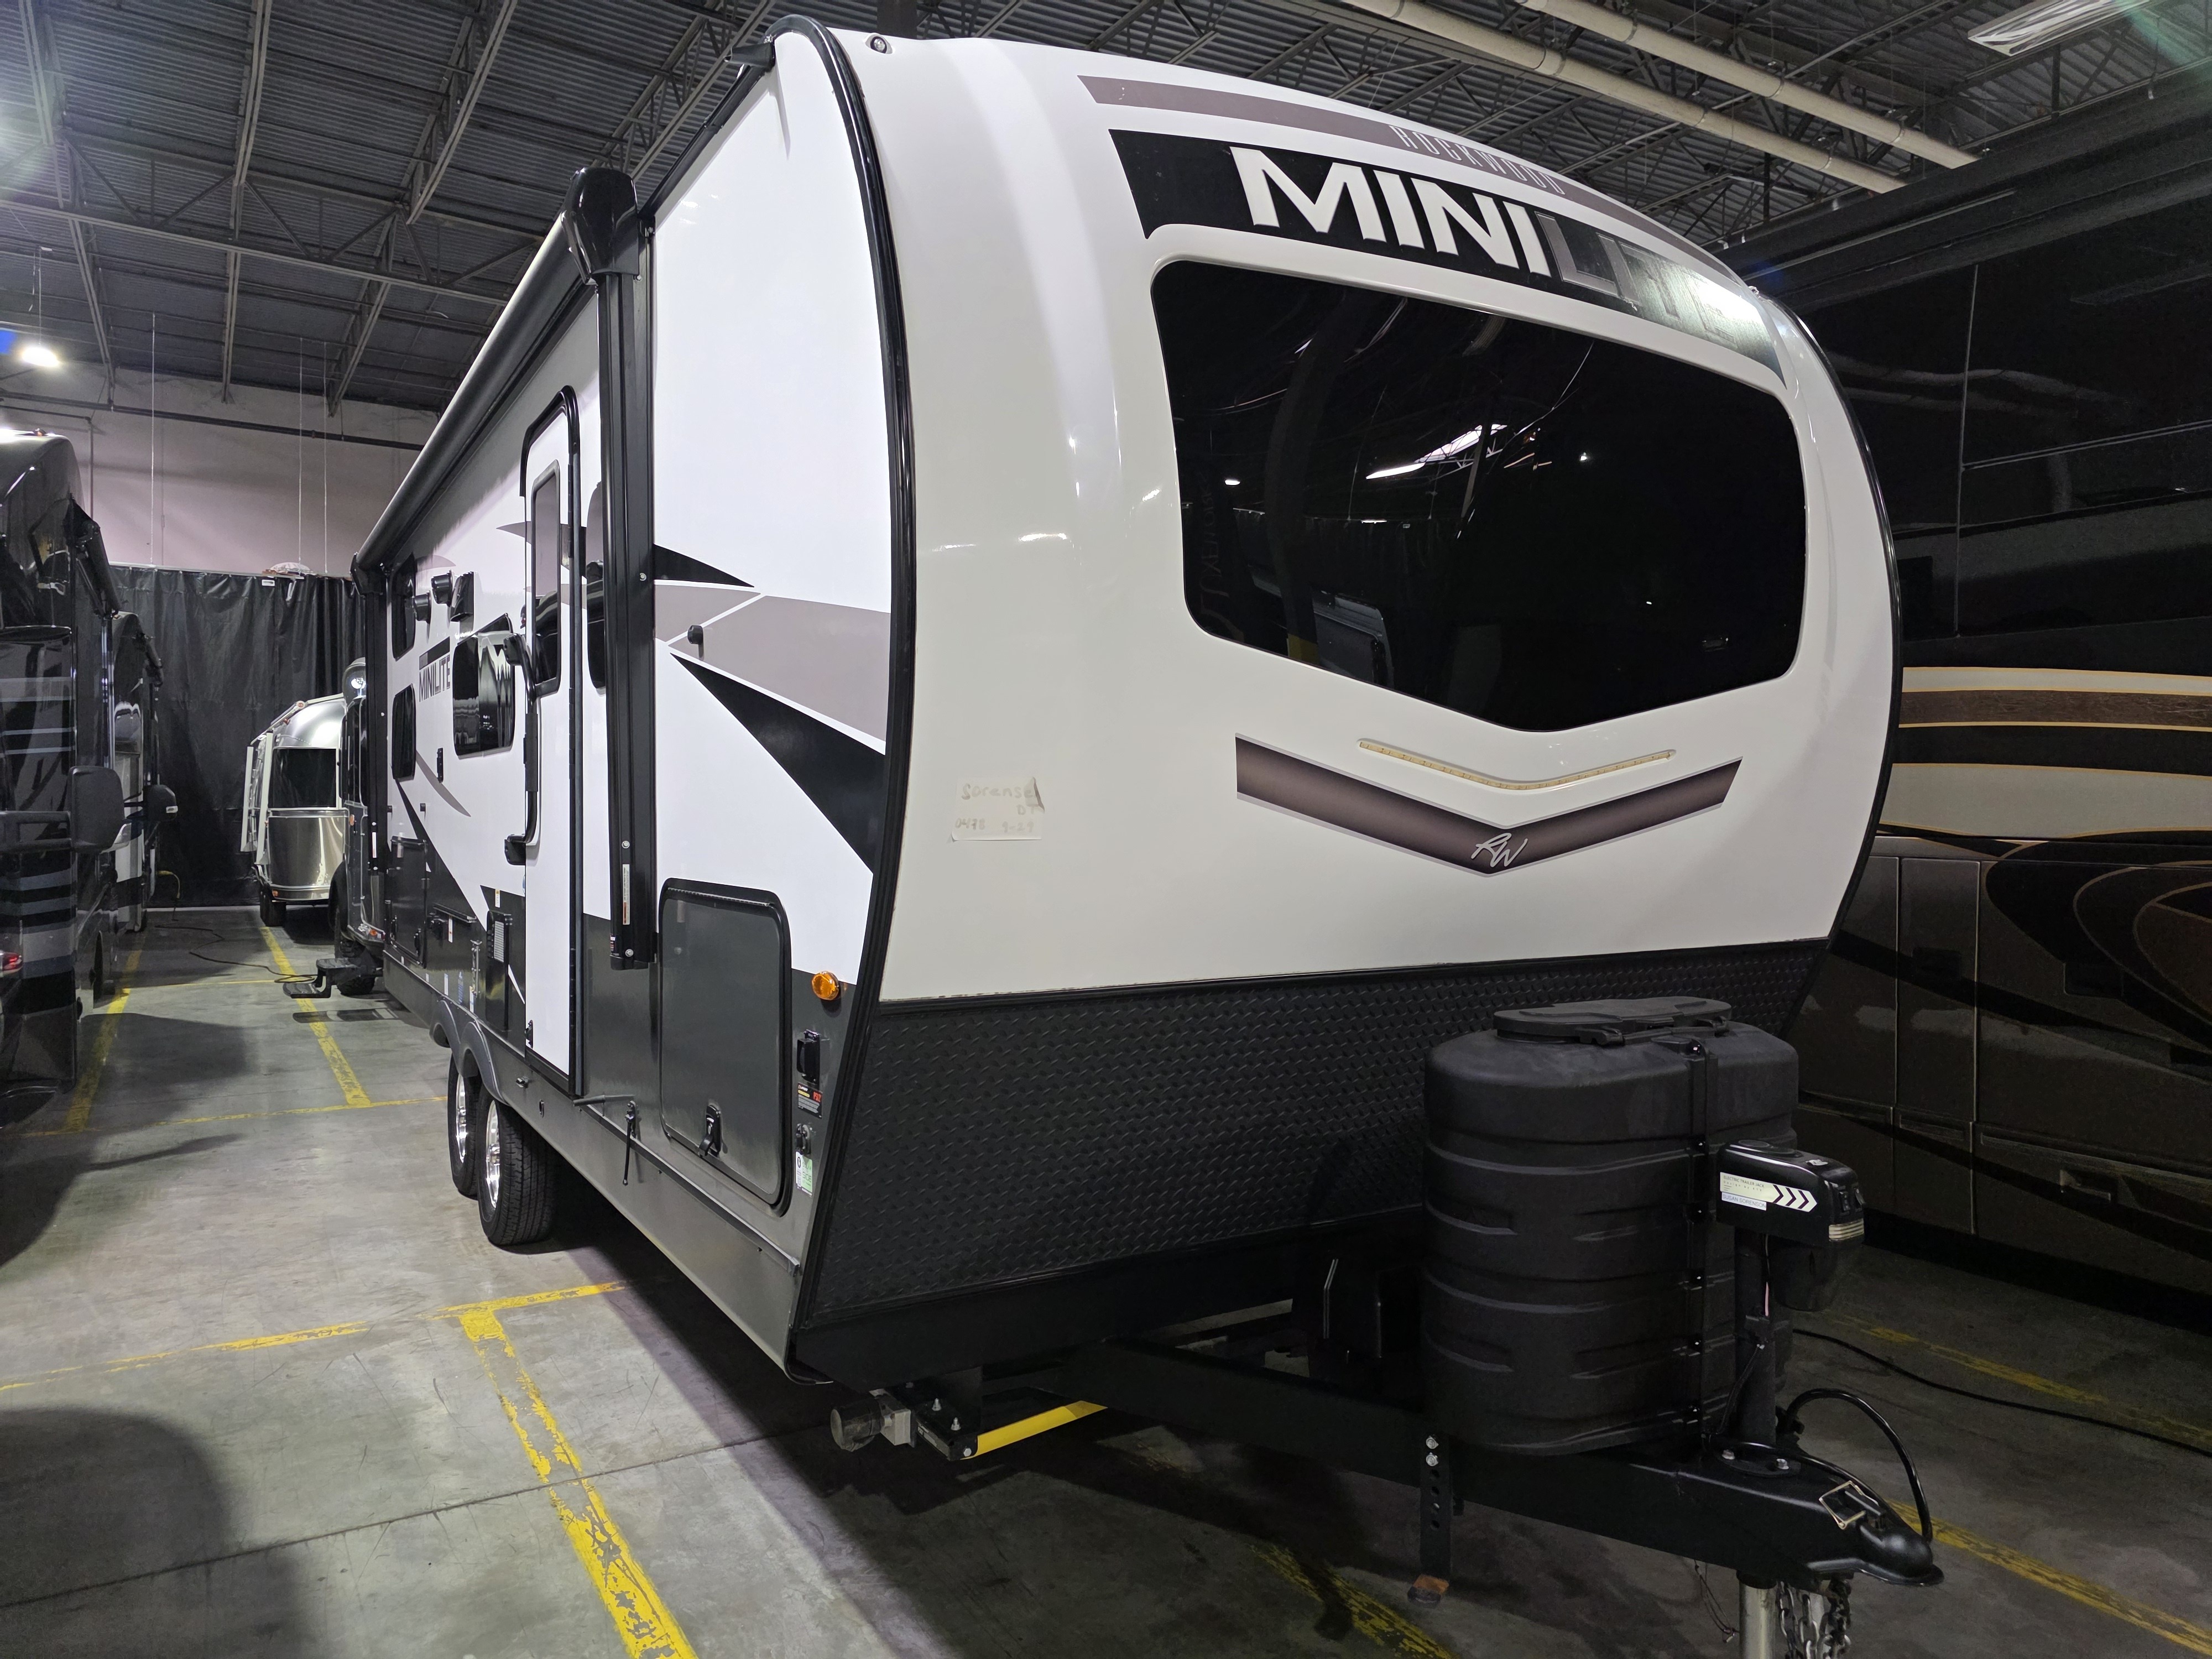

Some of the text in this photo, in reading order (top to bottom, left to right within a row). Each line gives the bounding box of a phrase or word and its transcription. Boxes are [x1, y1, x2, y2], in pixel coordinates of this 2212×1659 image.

[1388, 125, 1566, 195] ROCKWOOD
[419, 654, 451, 703] MINILITE
[961, 783, 1036, 801] Sorense
[1739, 1198, 1766, 1208] SORENSON
